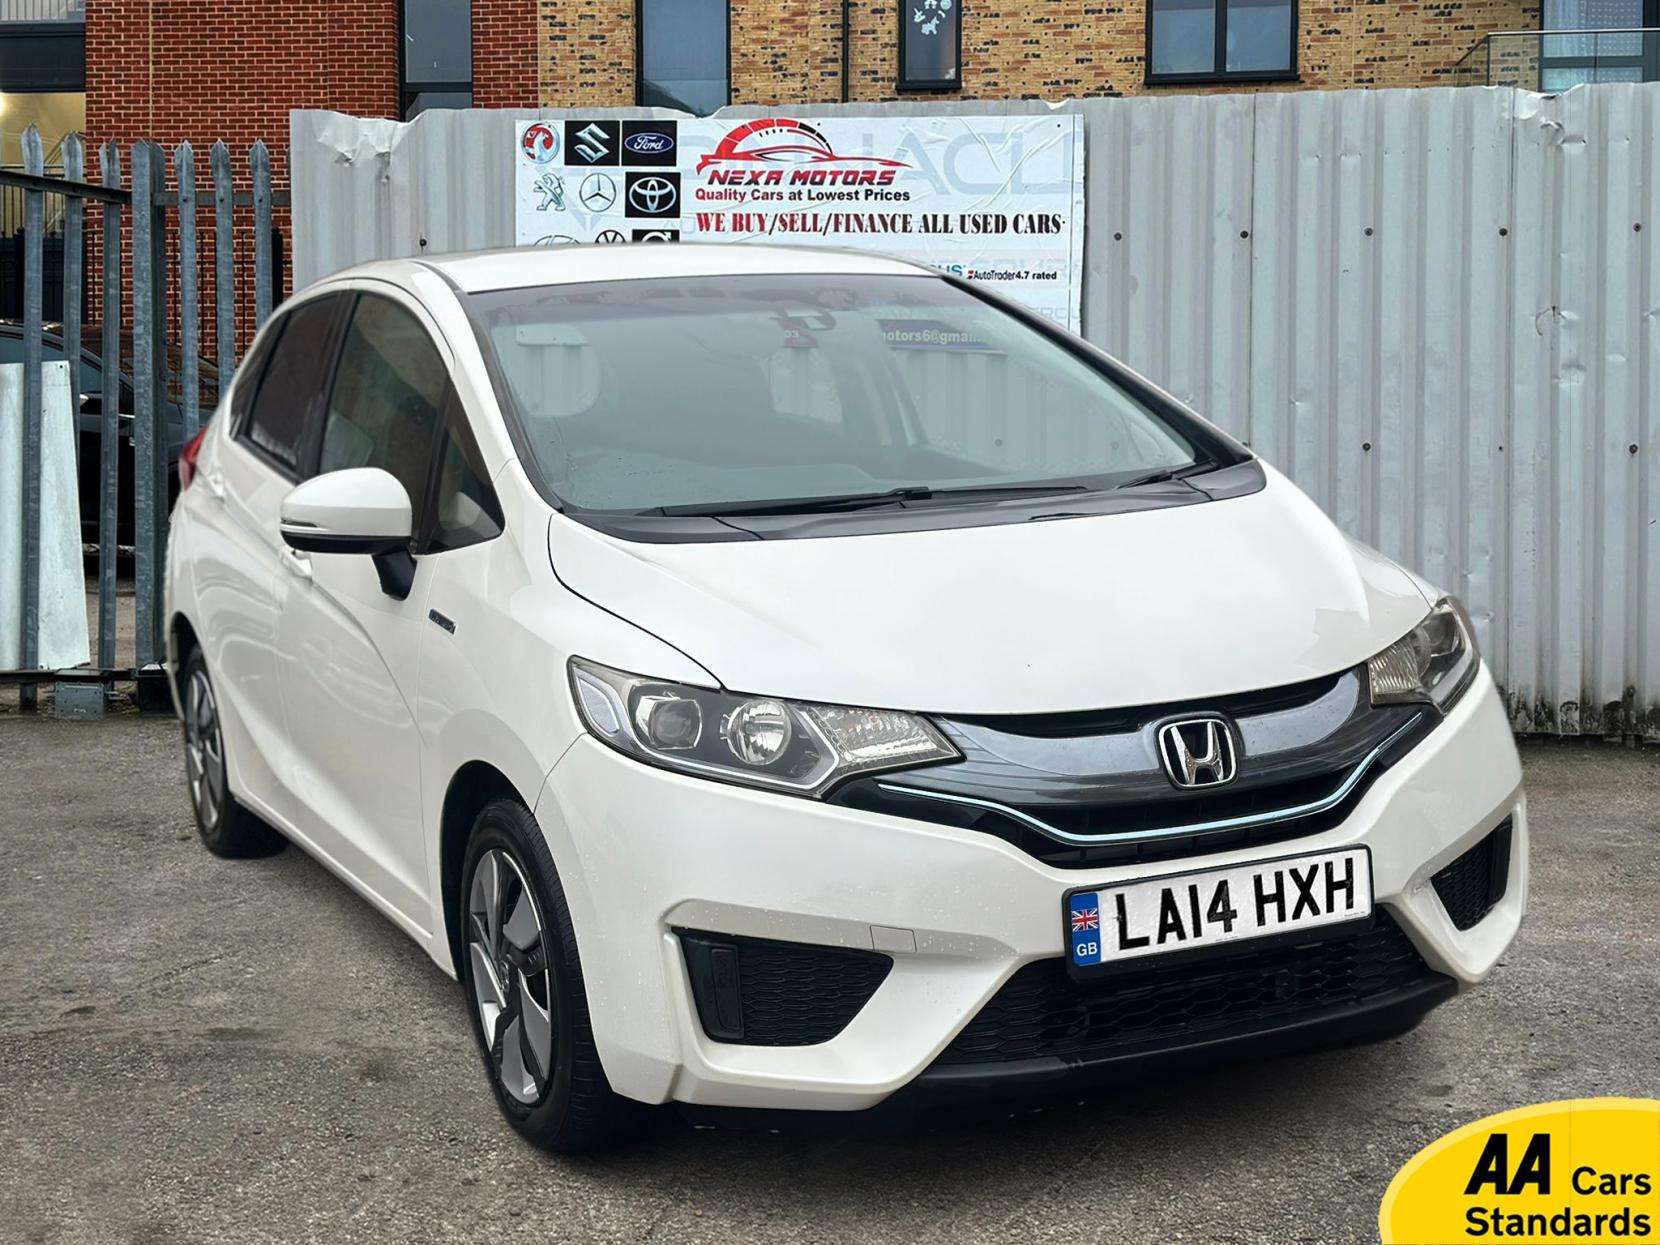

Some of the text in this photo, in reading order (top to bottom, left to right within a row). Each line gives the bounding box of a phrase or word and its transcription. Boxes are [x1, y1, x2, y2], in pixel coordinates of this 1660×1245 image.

[633, 134, 664, 151] Ford
[707, 170, 896, 186] NEXA MOTORS
[695, 188, 911, 203] Quality Cars at Lowest Prices
[695, 213, 726, 232] WE
[918, 213, 954, 234] ALL
[959, 213, 1008, 234] USED
[1012, 213, 1062, 234] CARS
[1032, 270, 1057, 280] rated
[1115, 857, 1354, 950] LA14 HXH
[1076, 942, 1098, 957] GB
